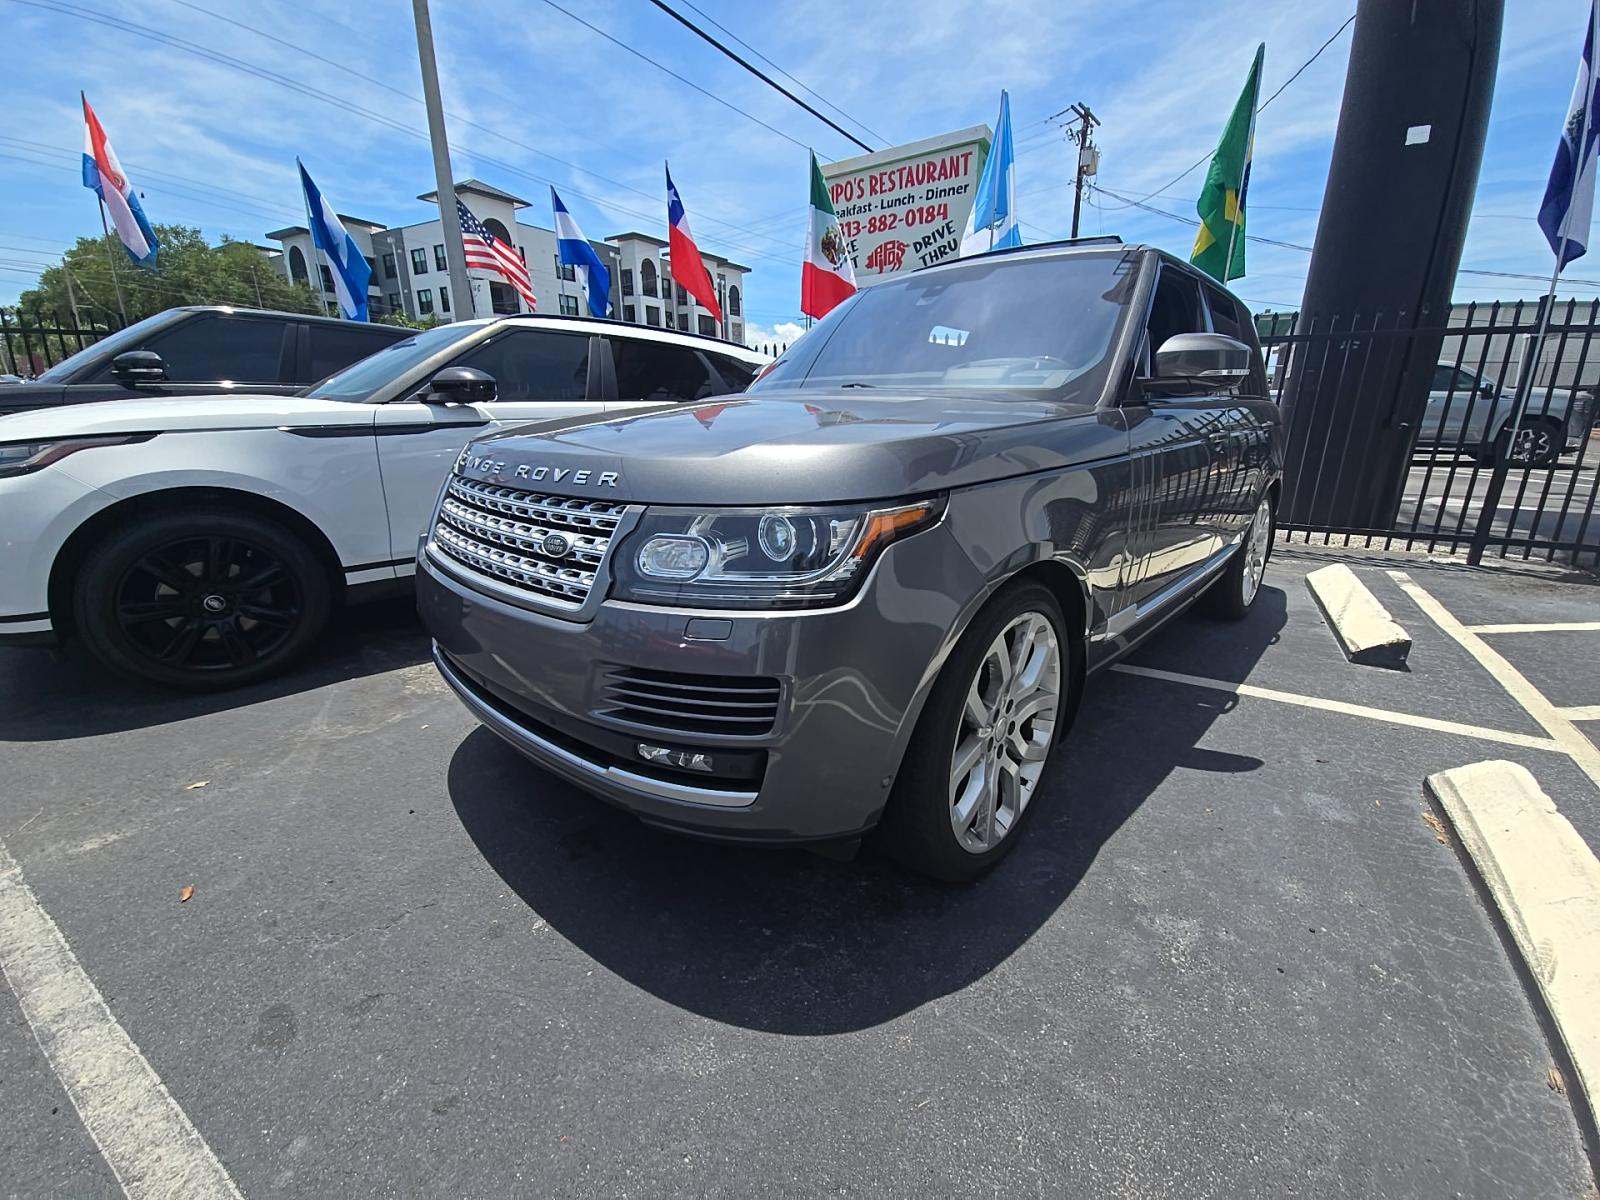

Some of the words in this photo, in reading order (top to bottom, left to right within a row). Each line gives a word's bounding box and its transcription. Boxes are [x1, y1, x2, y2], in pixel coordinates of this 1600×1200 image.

[829, 177, 865, 205] IPO'S
[869, 151, 973, 197] RESTAURANT
[835, 202, 872, 219] eakfast
[880, 193, 915, 210] Lunch
[925, 183, 970, 201] Dinner
[912, 219, 956, 254] DRIVE
[918, 237, 958, 267] THRU
[514, 464, 619, 487] ROVER
